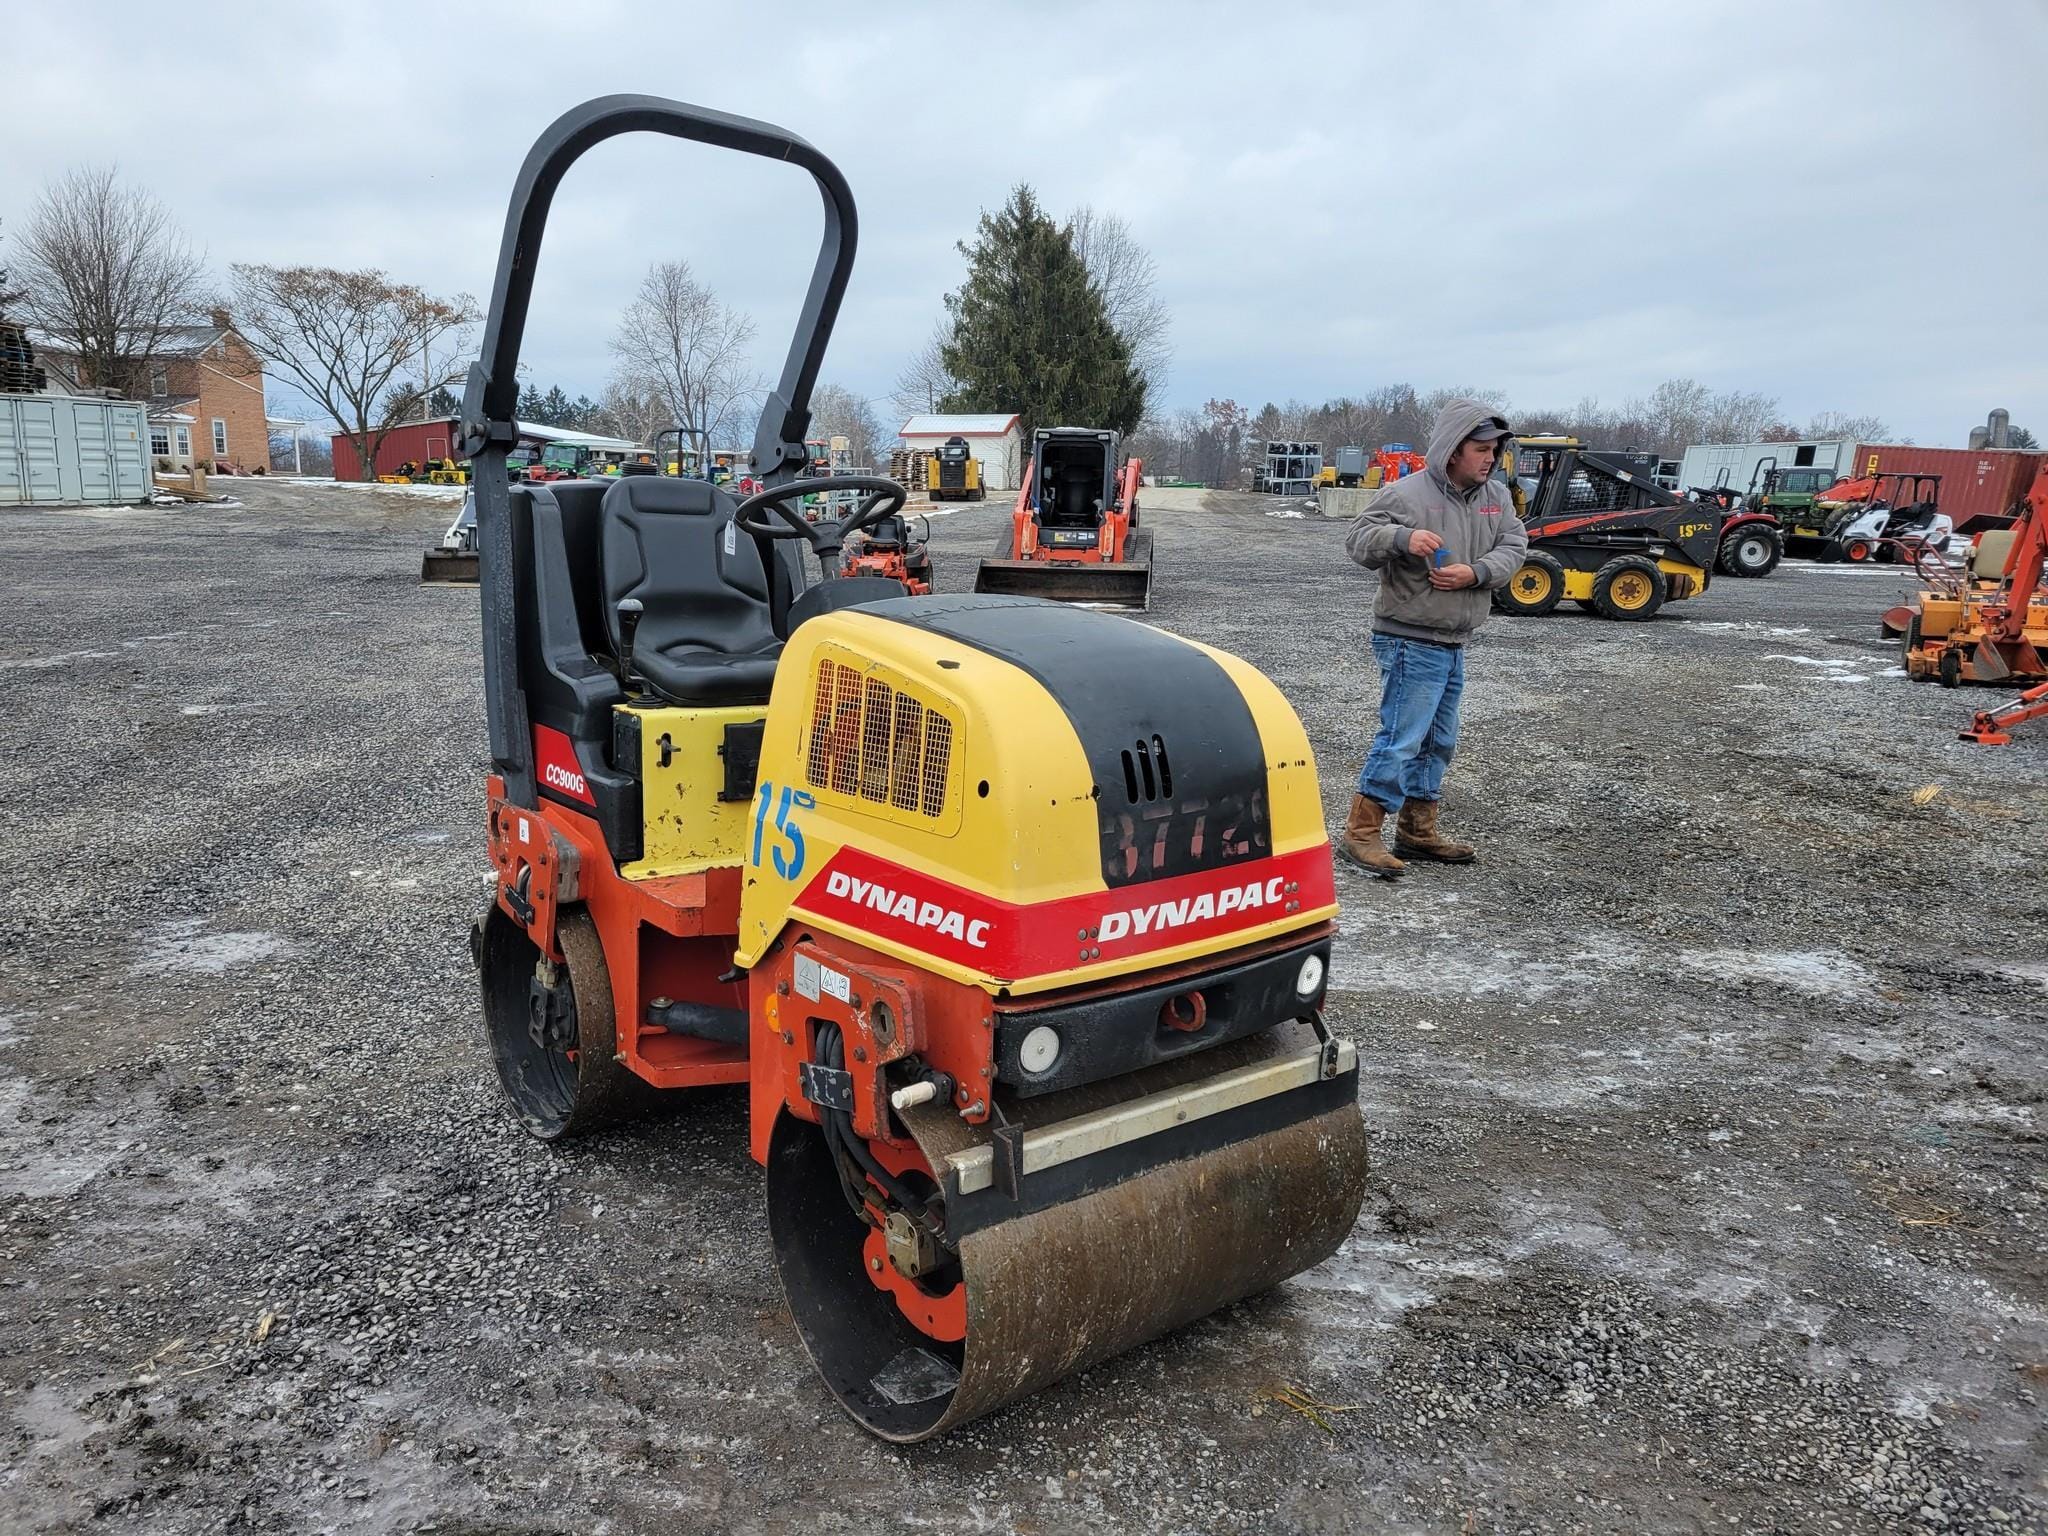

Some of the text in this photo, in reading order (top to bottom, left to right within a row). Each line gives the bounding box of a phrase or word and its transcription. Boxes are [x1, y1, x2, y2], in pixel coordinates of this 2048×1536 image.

[546, 763, 584, 794] CC900G
[753, 780, 816, 882] 15
[826, 870, 991, 948] DYNAPAC
[1097, 876, 1286, 943] DYNAPAC
